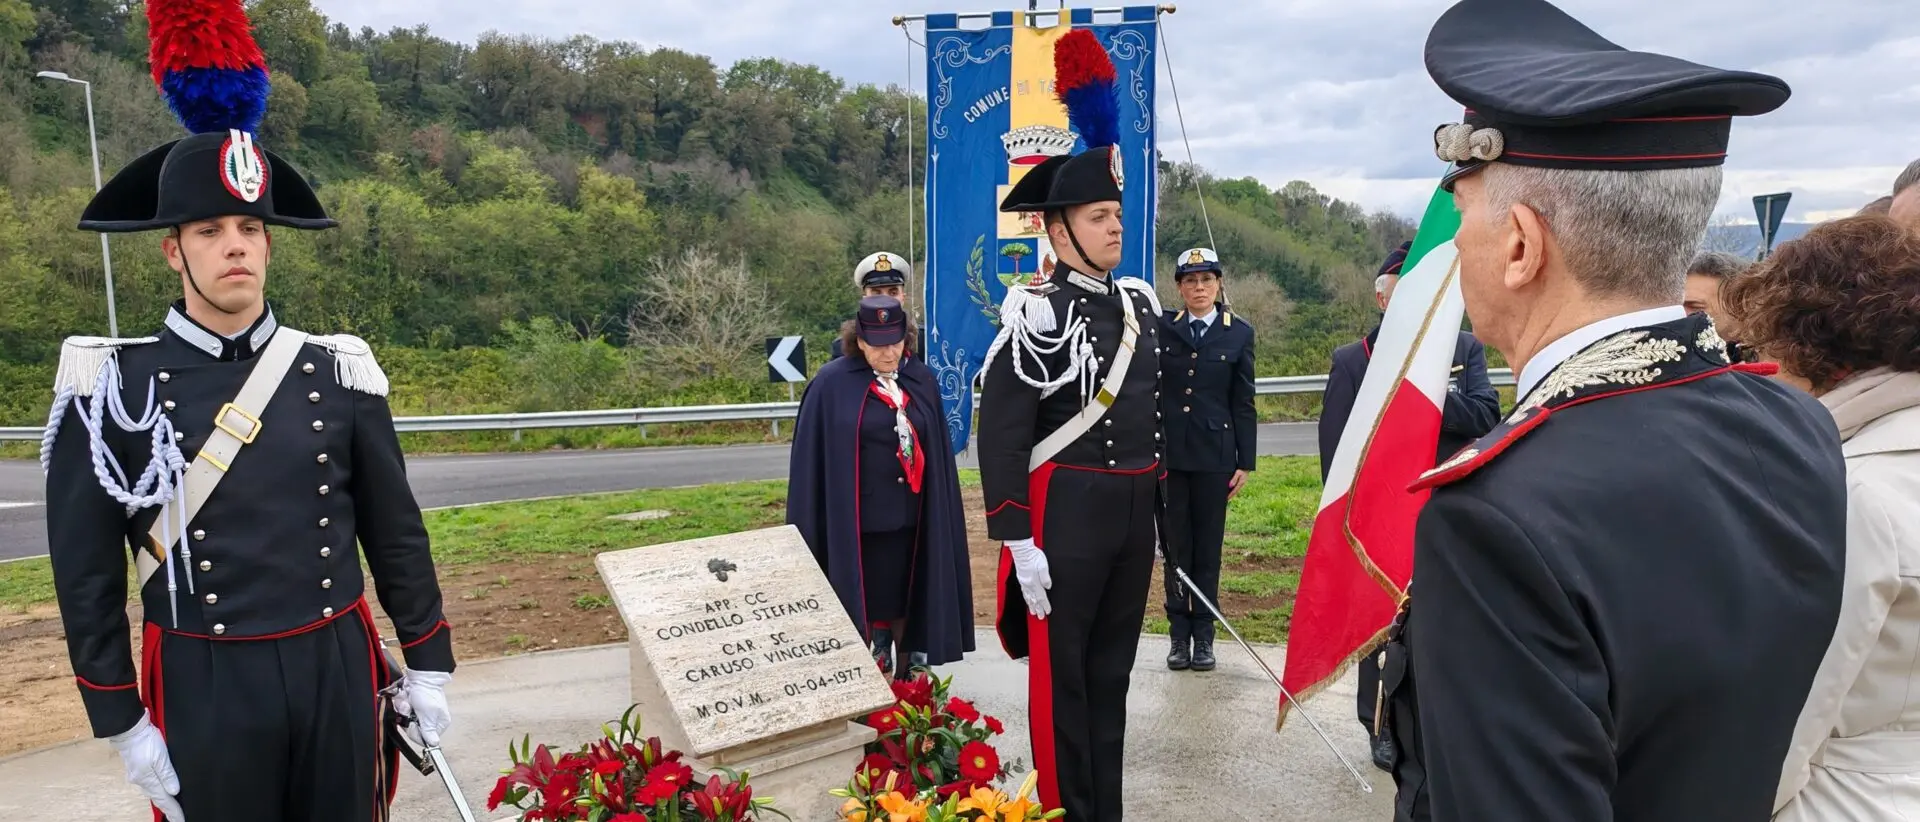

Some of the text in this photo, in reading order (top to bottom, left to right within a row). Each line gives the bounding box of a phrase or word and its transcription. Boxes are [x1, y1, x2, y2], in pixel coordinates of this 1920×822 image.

[963, 86, 1010, 123] COMUNE
[1016, 80, 1029, 96] DI
[705, 592, 768, 613] APP. CC
[657, 598, 819, 641] CONDELLO STEFANO
[722, 631, 794, 656] CAR. SC.
[685, 657, 754, 683] CARUSO
[784, 667, 862, 696] 01-04-1977
